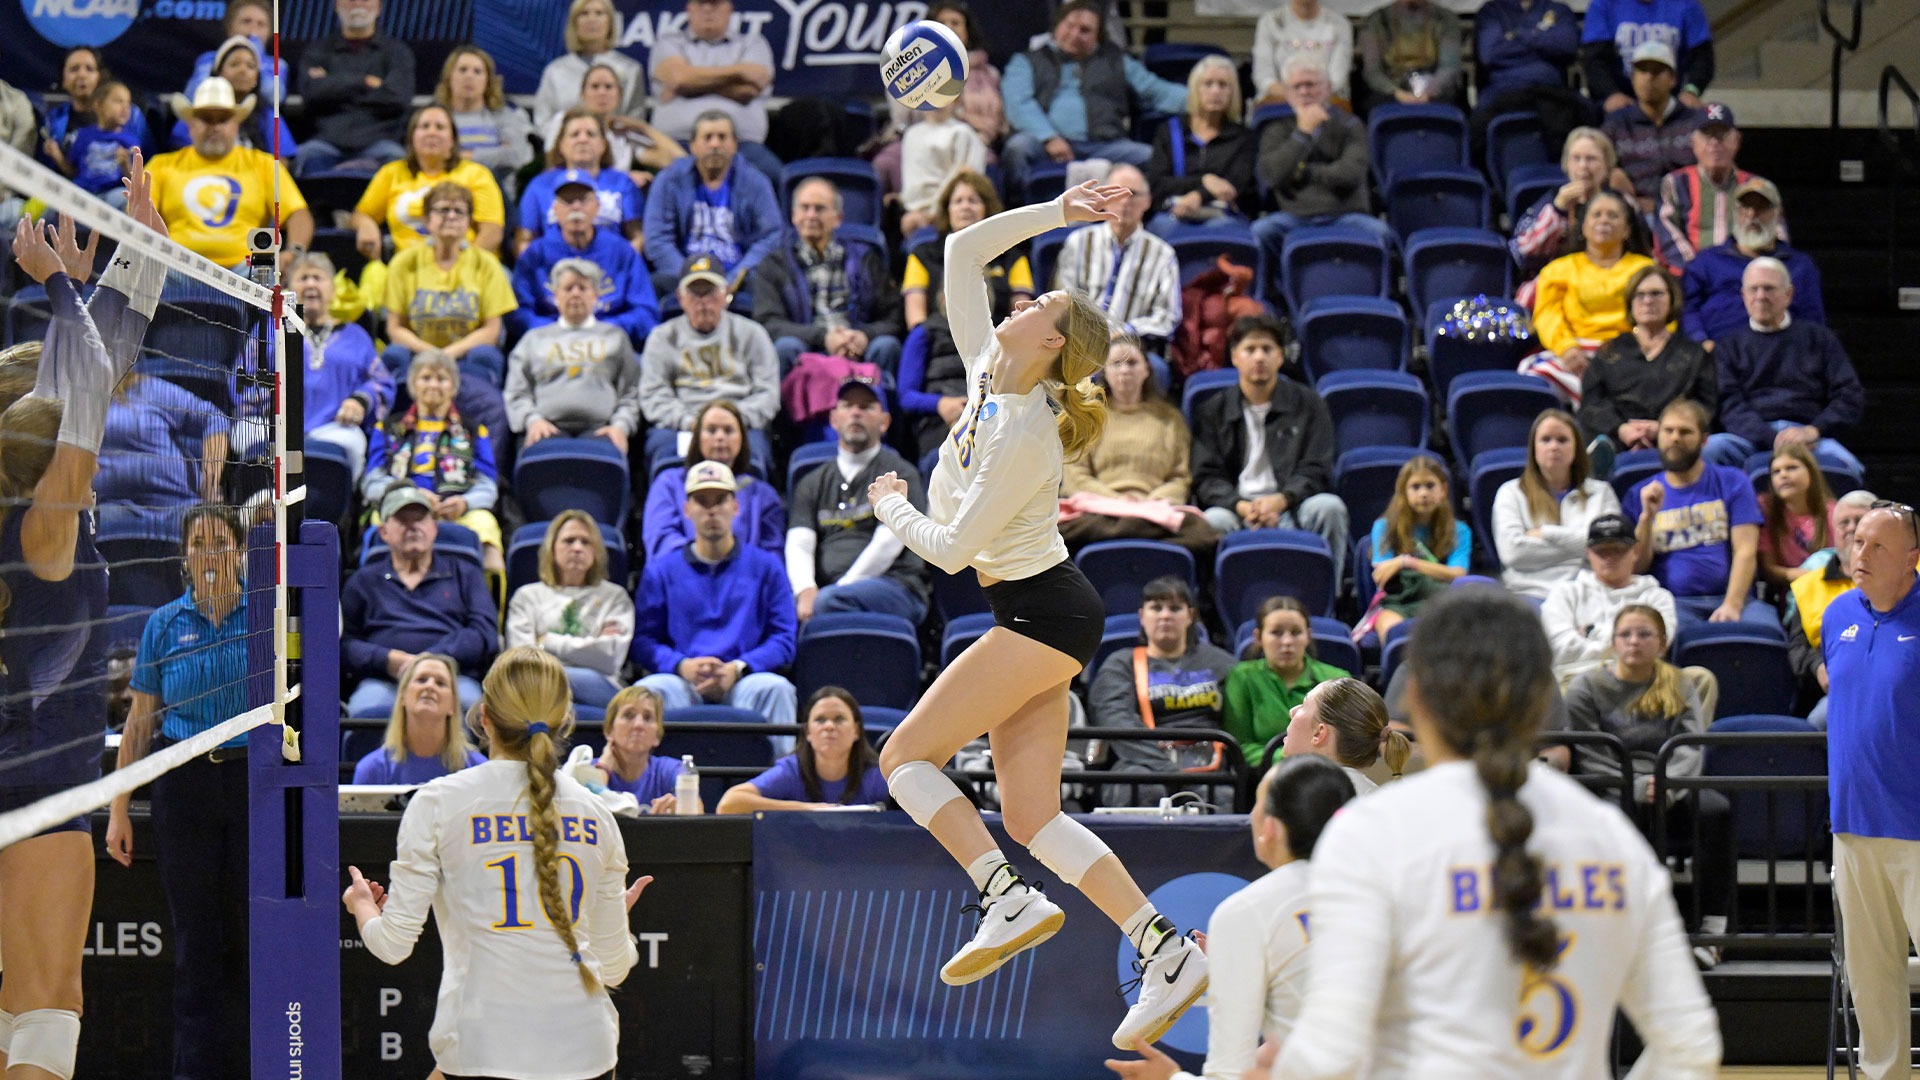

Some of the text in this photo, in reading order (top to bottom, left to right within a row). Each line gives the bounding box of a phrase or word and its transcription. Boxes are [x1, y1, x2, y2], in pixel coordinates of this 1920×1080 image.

[885, 46, 922, 80] molten
[894, 62, 929, 94] NCAA
[546, 341, 606, 365] ASU
[470, 813, 598, 846] BELES
[485, 852, 585, 930] 10
[380, 987, 403, 1017] P
[285, 1001, 304, 1057] sports
[380, 1031, 403, 1061] B
